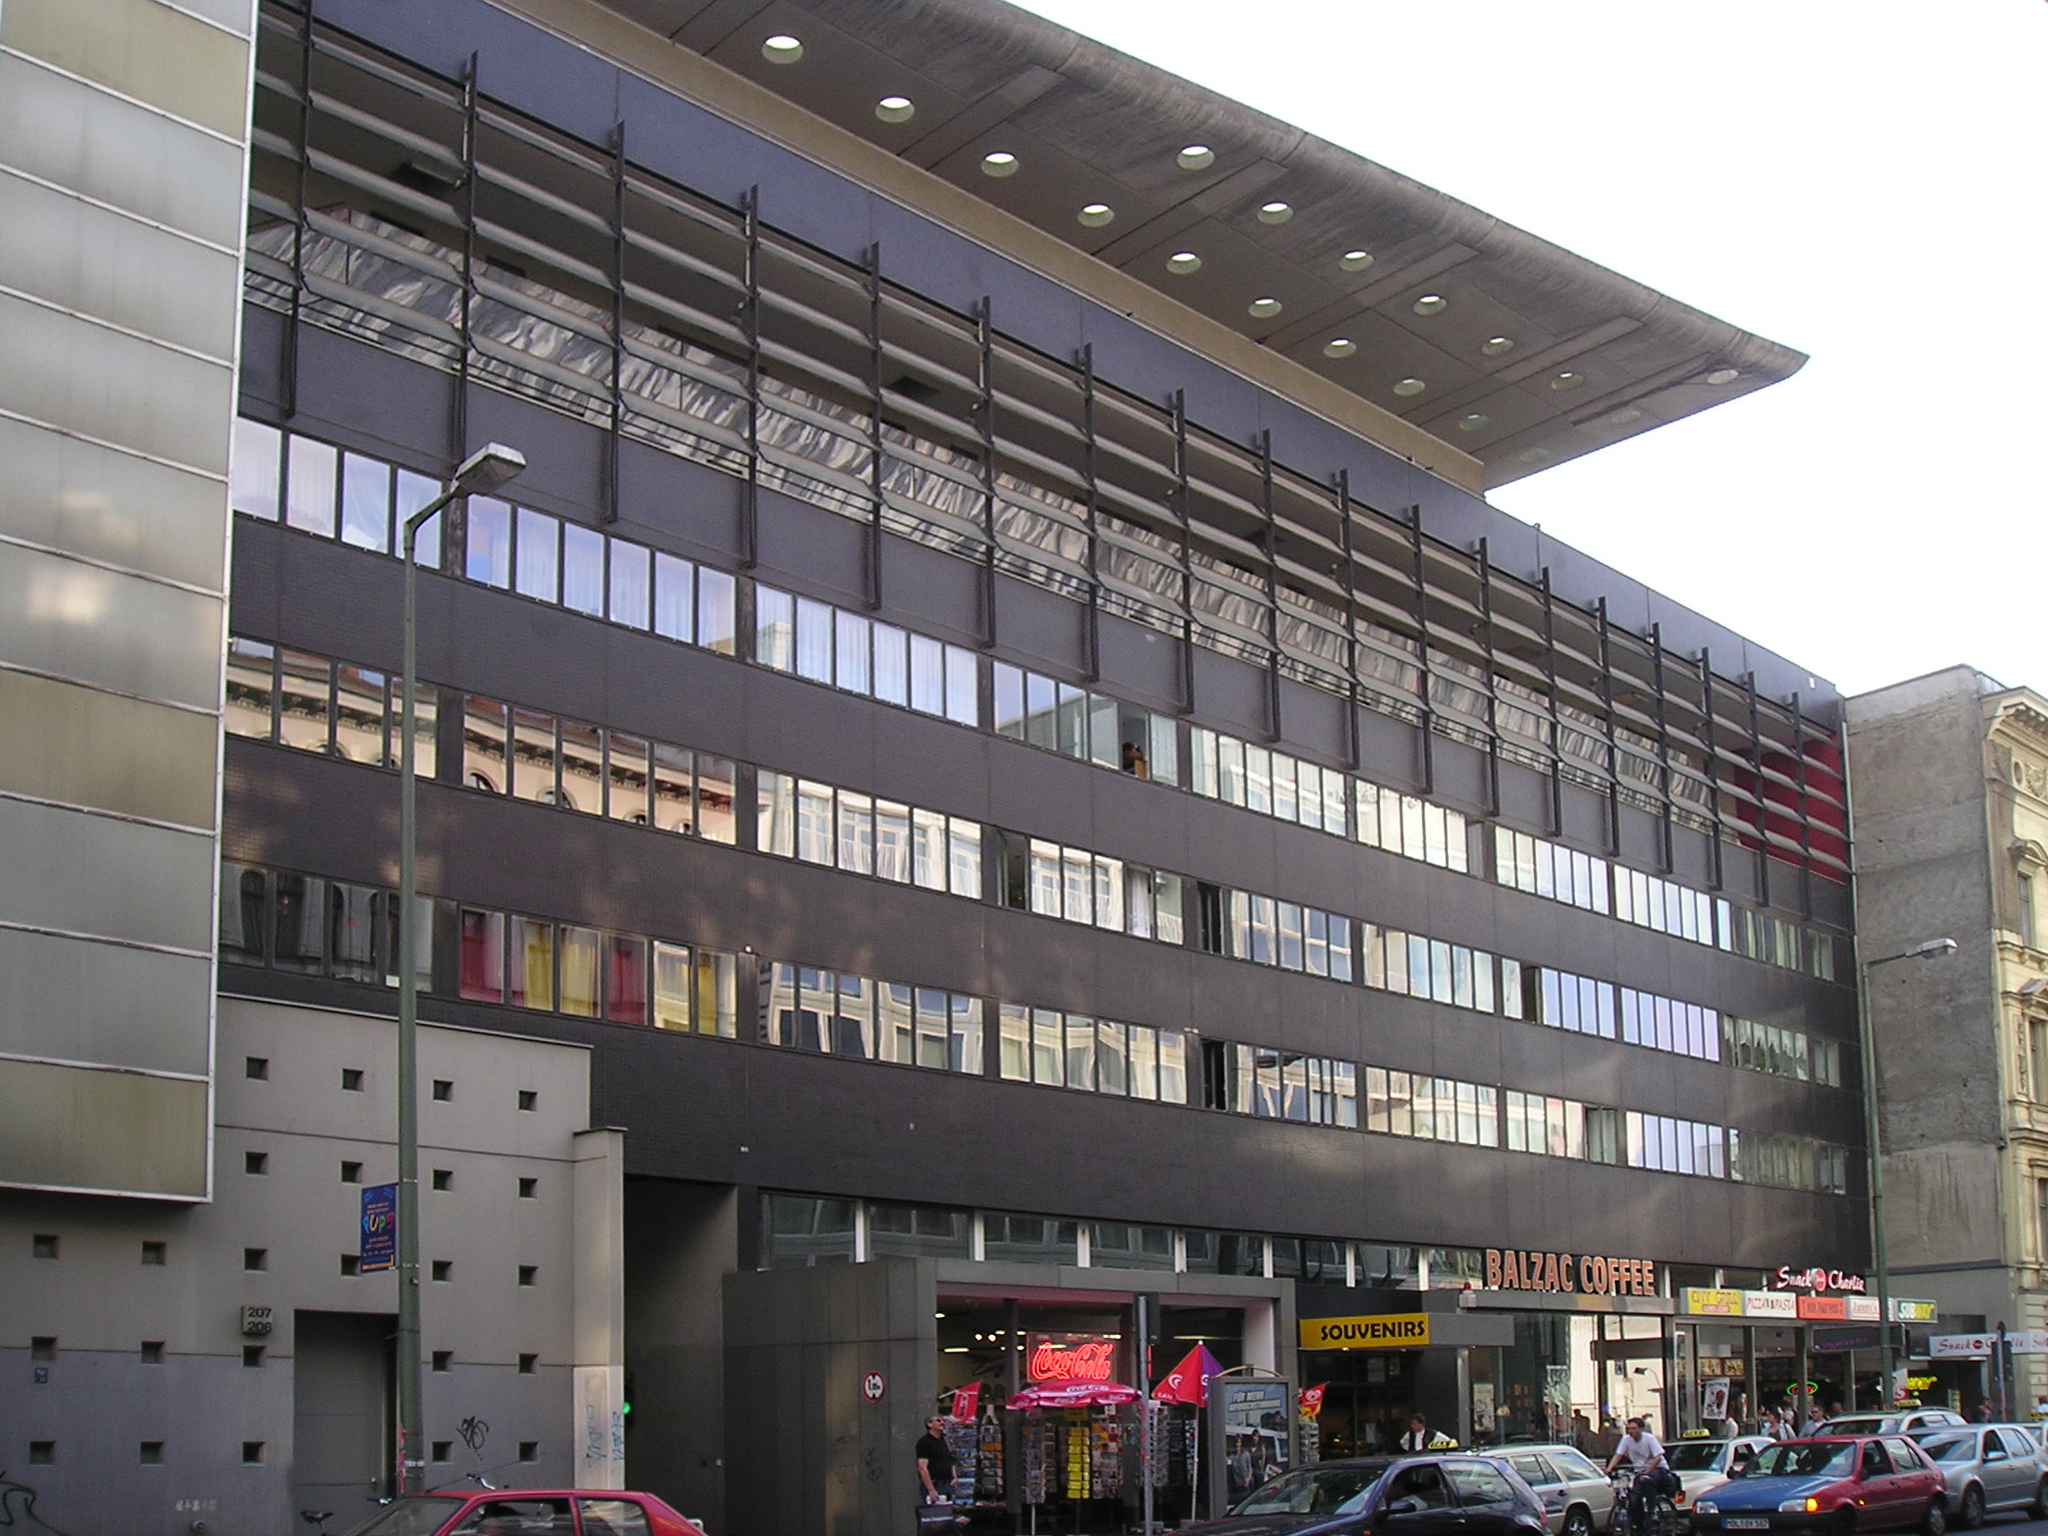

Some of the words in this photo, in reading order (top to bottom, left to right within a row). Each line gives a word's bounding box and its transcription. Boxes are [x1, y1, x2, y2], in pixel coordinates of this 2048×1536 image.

[1486, 1248, 1574, 1293] BALZAC
[1579, 1255, 1655, 1297] COFFEE
[1775, 1265, 1812, 1289] Snack
[1828, 1269, 1865, 1292] Charlie
[247, 1307, 271, 1318] 207
[1747, 1297, 1766, 1310] PIZZA
[1774, 1298, 1795, 1311] PASTA
[1321, 1320, 1425, 1341] SOUVENIRS
[1938, 1339, 1971, 1353] Snack
